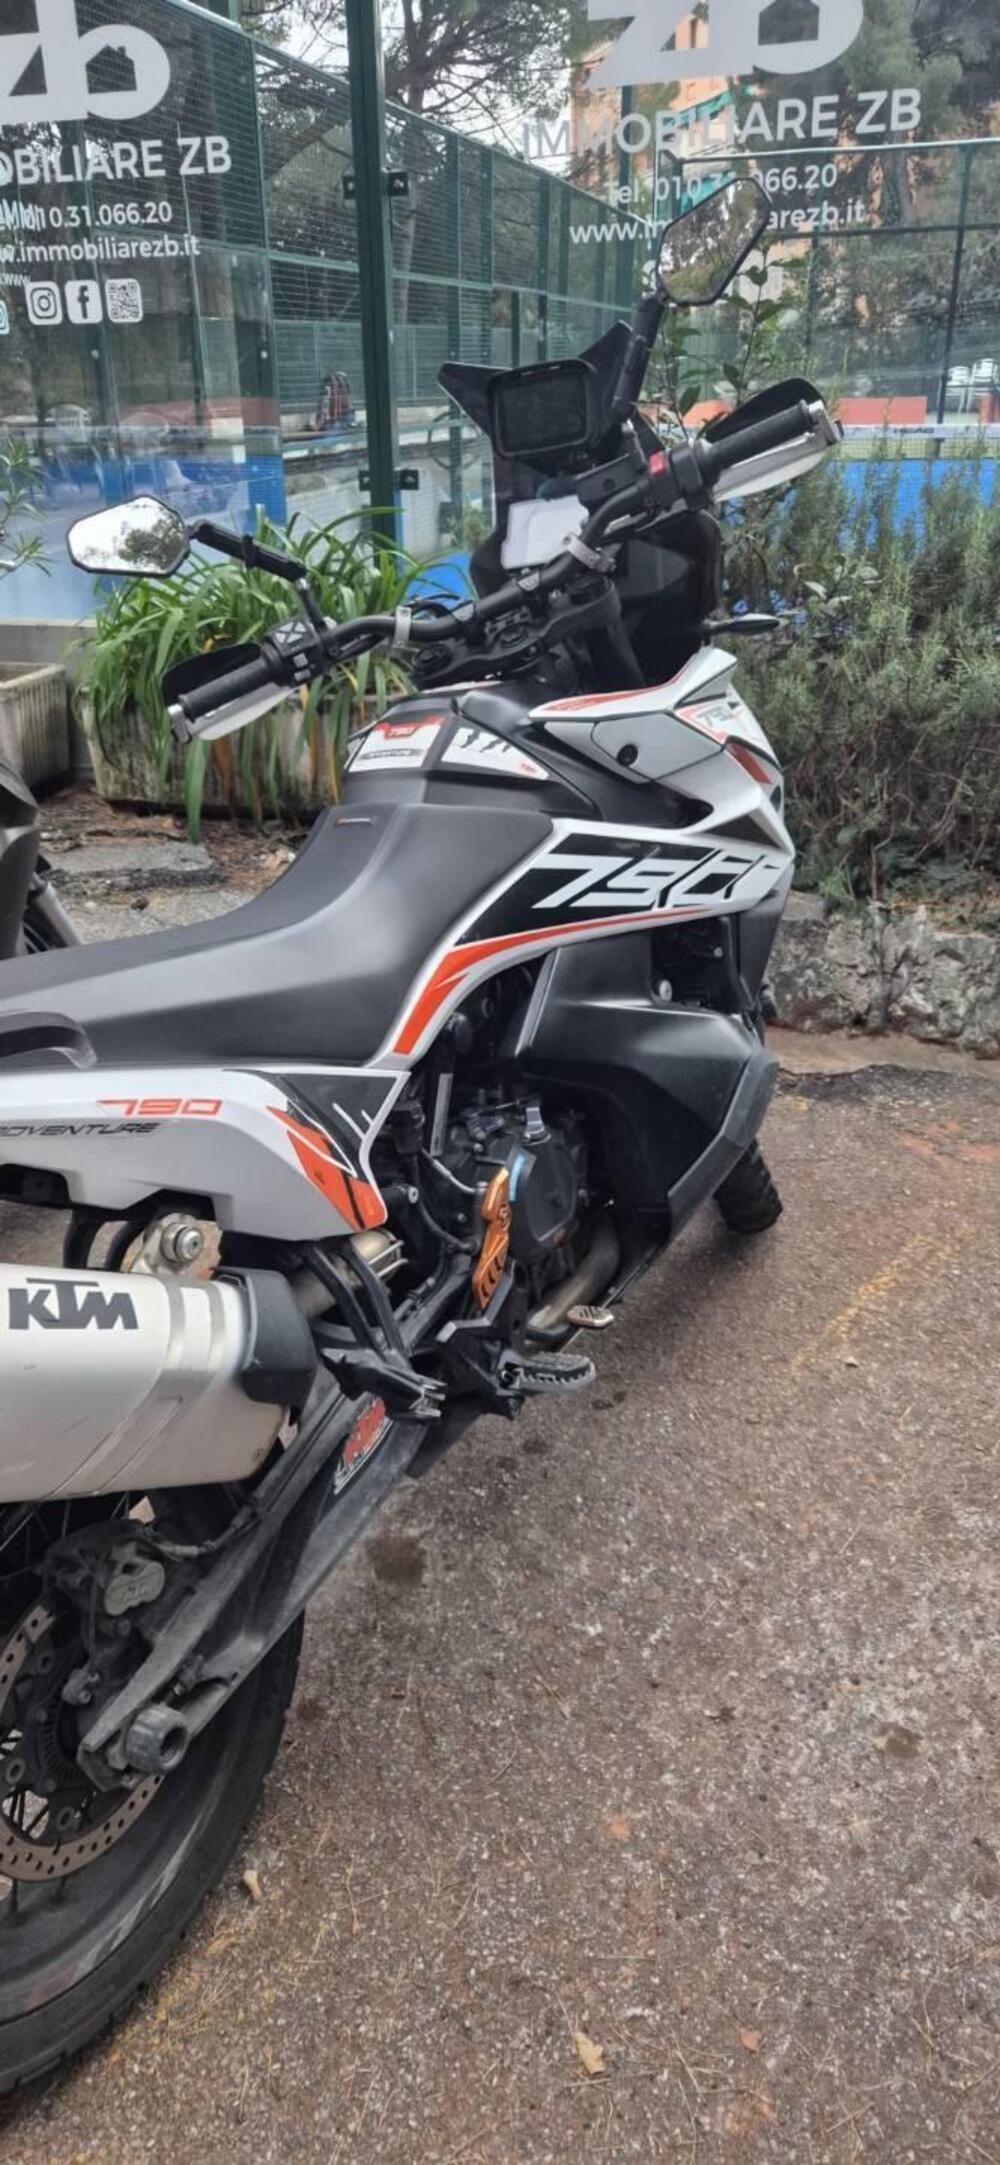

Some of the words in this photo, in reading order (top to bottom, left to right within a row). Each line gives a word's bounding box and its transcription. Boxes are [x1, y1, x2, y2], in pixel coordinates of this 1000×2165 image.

[522, 95, 839, 158] IMMOBILIARE
[855, 88, 922, 134] ZB
[178, 135, 232, 176] ZB
[96, 1098, 223, 1116] 790
[8, 1277, 139, 1330] KTM
